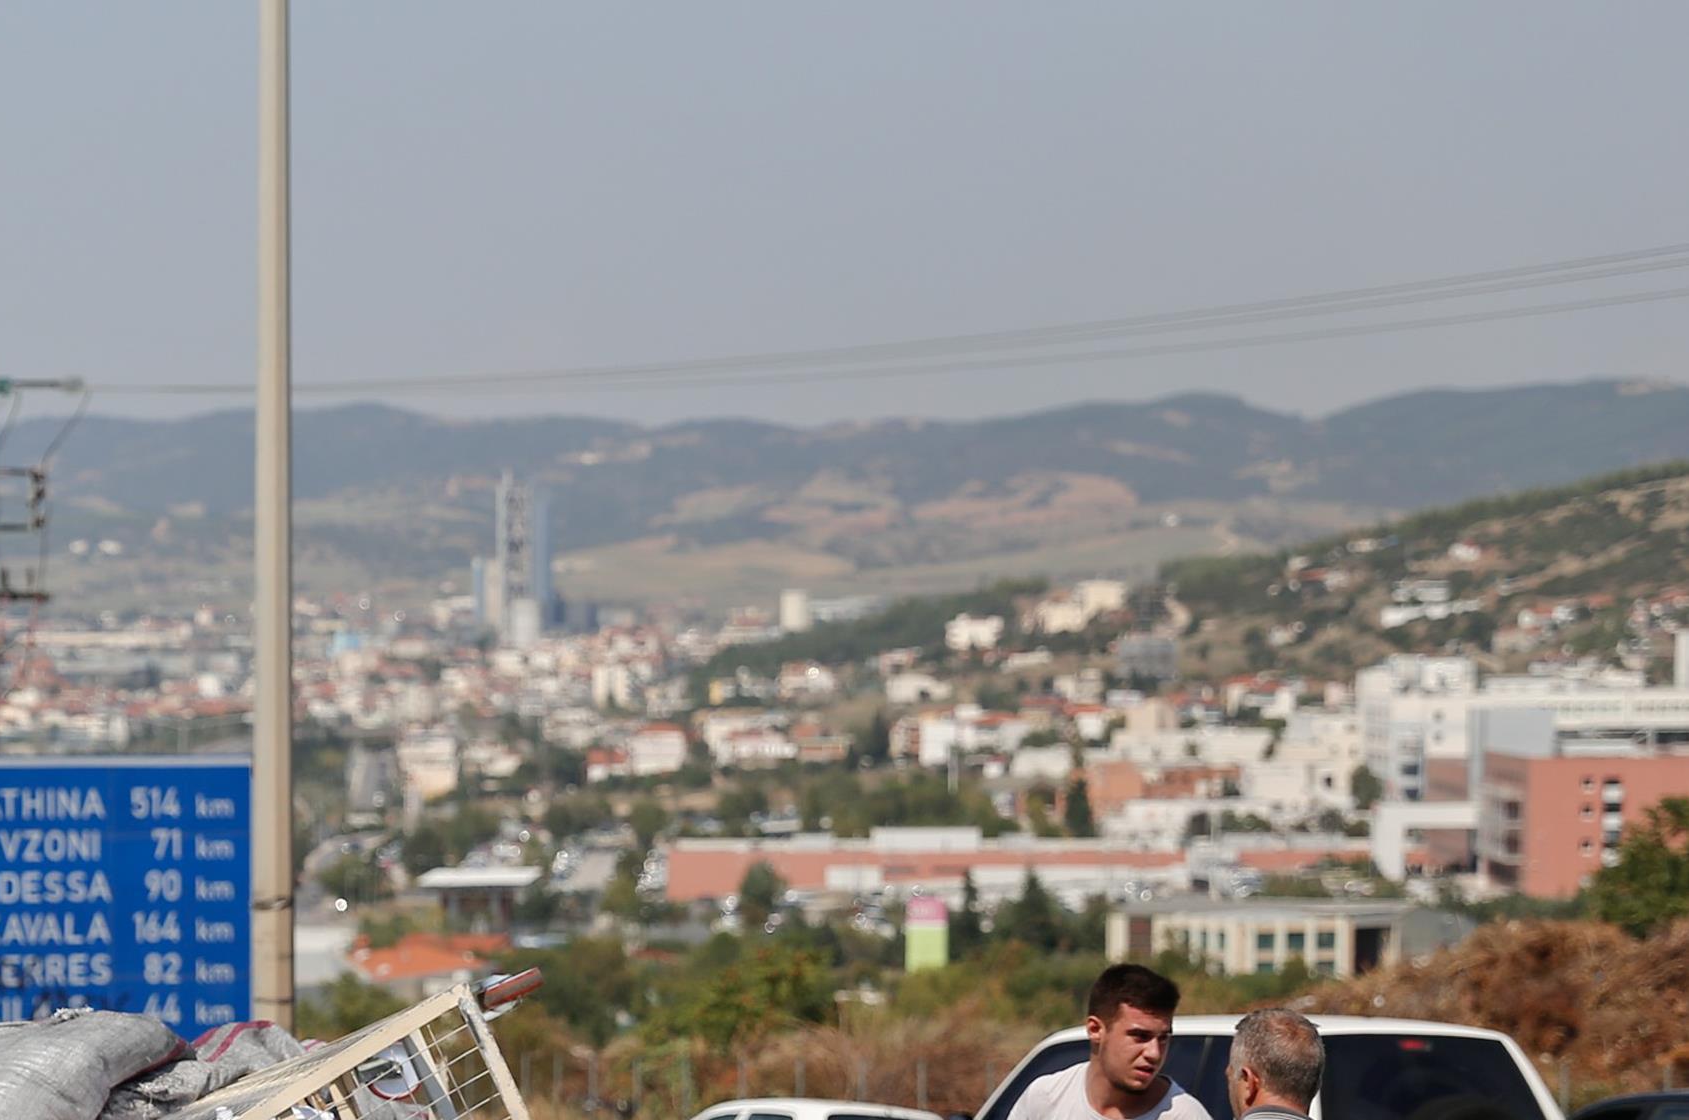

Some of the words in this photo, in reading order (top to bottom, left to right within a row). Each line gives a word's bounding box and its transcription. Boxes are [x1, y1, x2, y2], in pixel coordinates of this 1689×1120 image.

[131, 787, 180, 818] 514
[195, 793, 234, 817] km
[151, 828, 182, 858] 71
[195, 833, 234, 858] km
[145, 869, 181, 901] 90
[196, 875, 234, 899] km
[133, 912, 180, 943] 164
[196, 917, 234, 941] km
[144, 953, 181, 984] 82
[196, 958, 234, 982] km
[195, 999, 234, 1024] km
